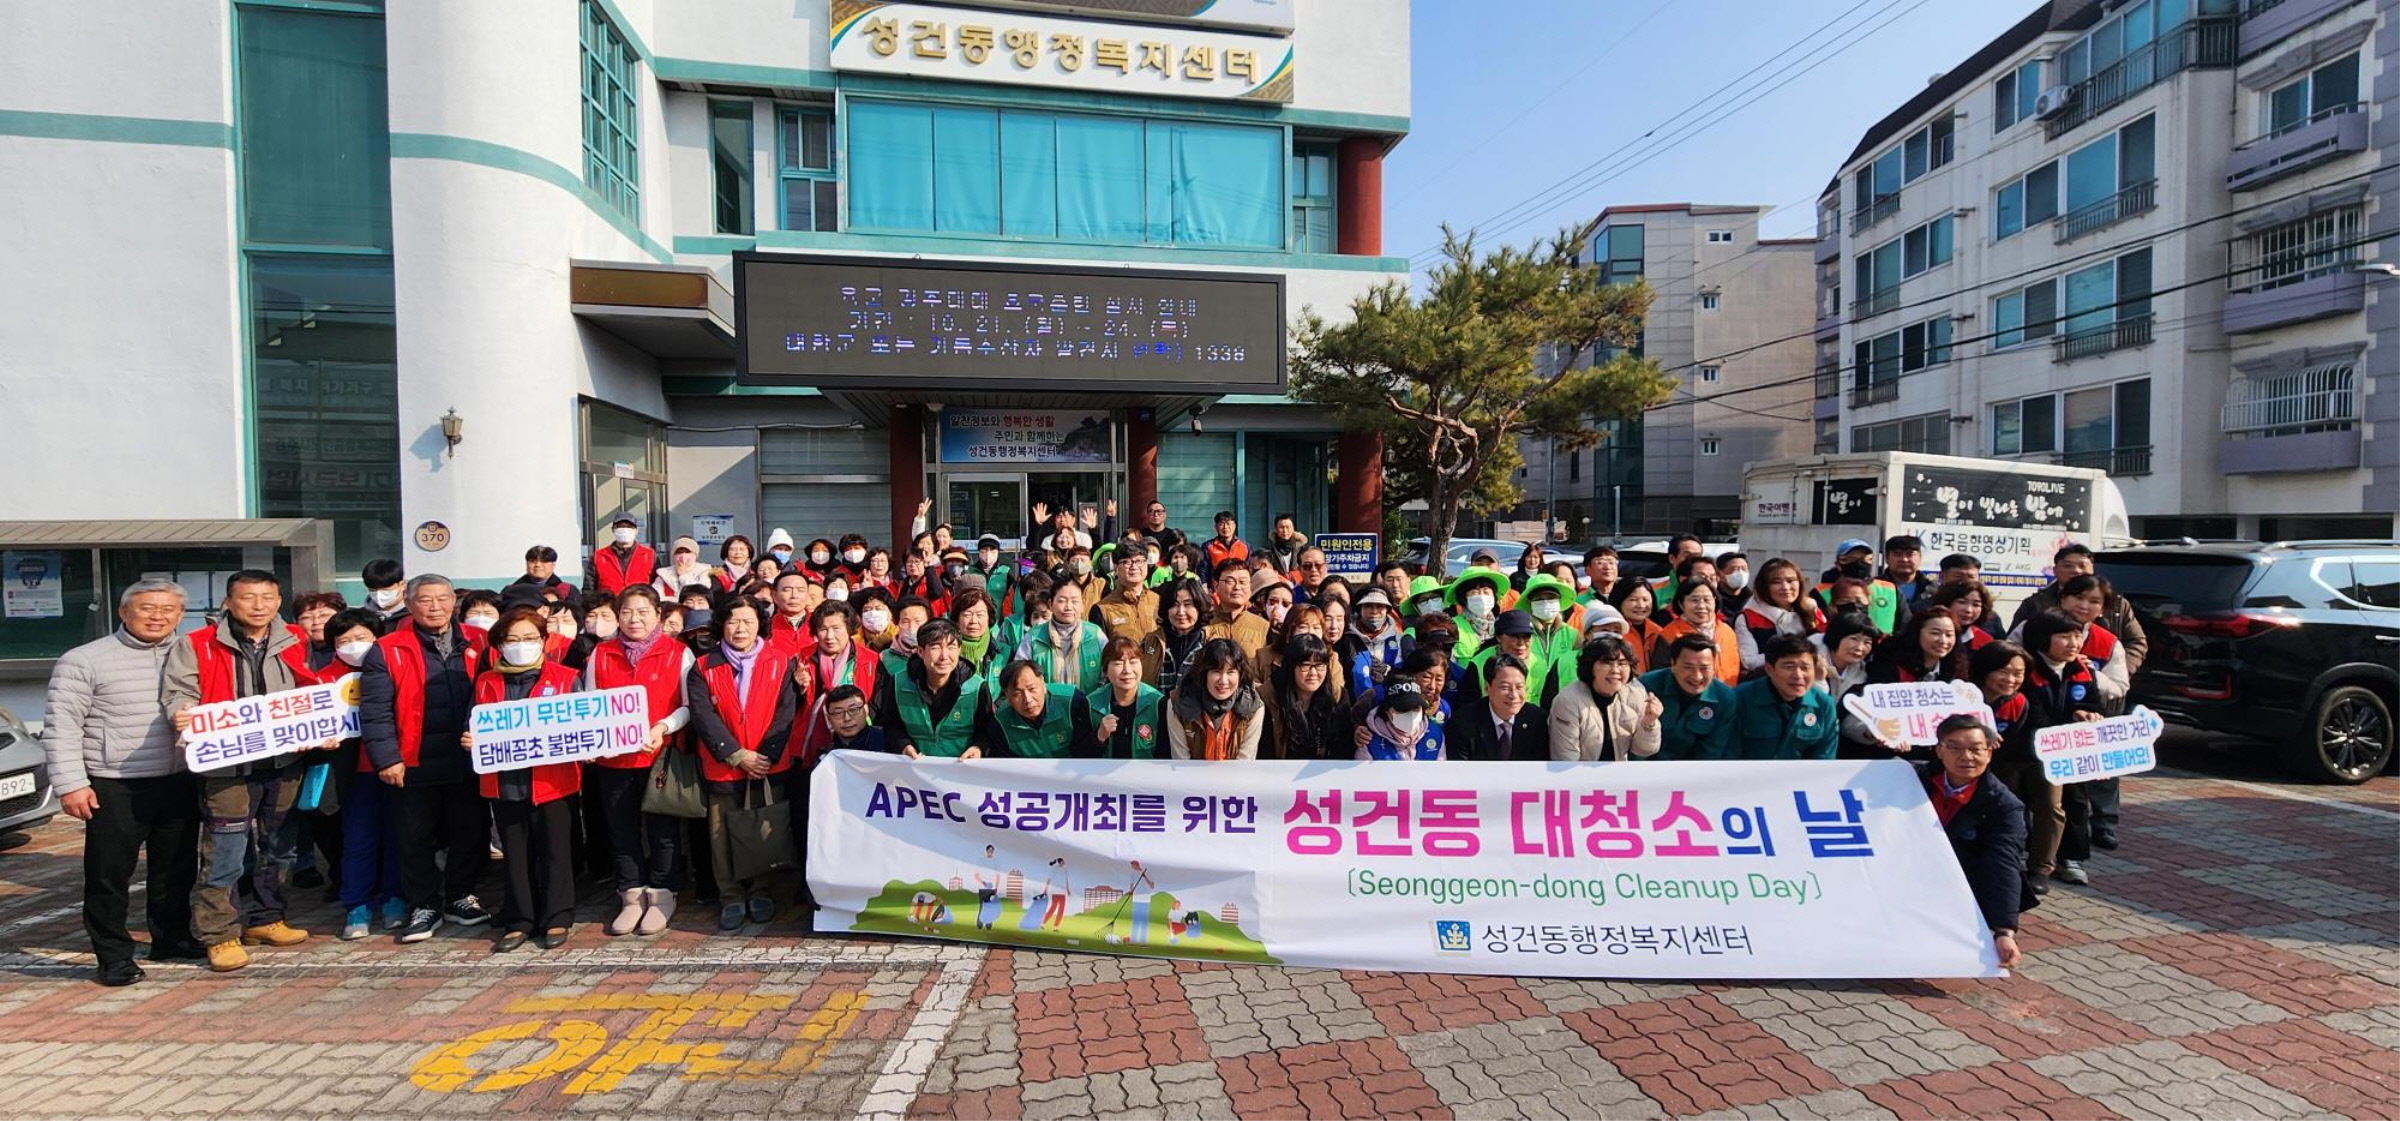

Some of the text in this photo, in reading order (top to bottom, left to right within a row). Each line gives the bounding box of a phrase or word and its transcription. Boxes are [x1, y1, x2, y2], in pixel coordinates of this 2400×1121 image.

[862, 16, 1260, 84] 성건동행정복지센터
[994, 430, 1066, 444] 주민과 함께하는
[1002, 414, 1033, 428] 행복한
[1034, 414, 1056, 429] 생활
[968, 444, 1057, 459] 성건동행정복지센터
[421, 533, 445, 542] 370
[1320, 538, 1373, 552] 민원인전용
[1930, 531, 2032, 556] 한국음향영상기획
[191, 690, 335, 735] 미소와 친절로
[477, 692, 641, 733] 쓰레기 무단투기 NO!
[1871, 687, 1955, 709] 내 집앞 청소는
[196, 712, 362, 765] 손님를 맞이합시
[1908, 713, 1928, 739] 내
[2040, 720, 2151, 752] 쓰레기 없는 깨끗한 거리
[479, 724, 643, 767] 담배꽁초 불법투기 NO!
[2050, 746, 2150, 778] 우리 같이 만들어요!
[1, 778, 26, 796] 892
[865, 782, 1259, 834] APEC 성공개최를 위한
[1283, 788, 1875, 859] 성건동 대청소의 날
[1614, 871, 1740, 904] Cleanup
[1481, 923, 1754, 956] 성건동행정복지센터
